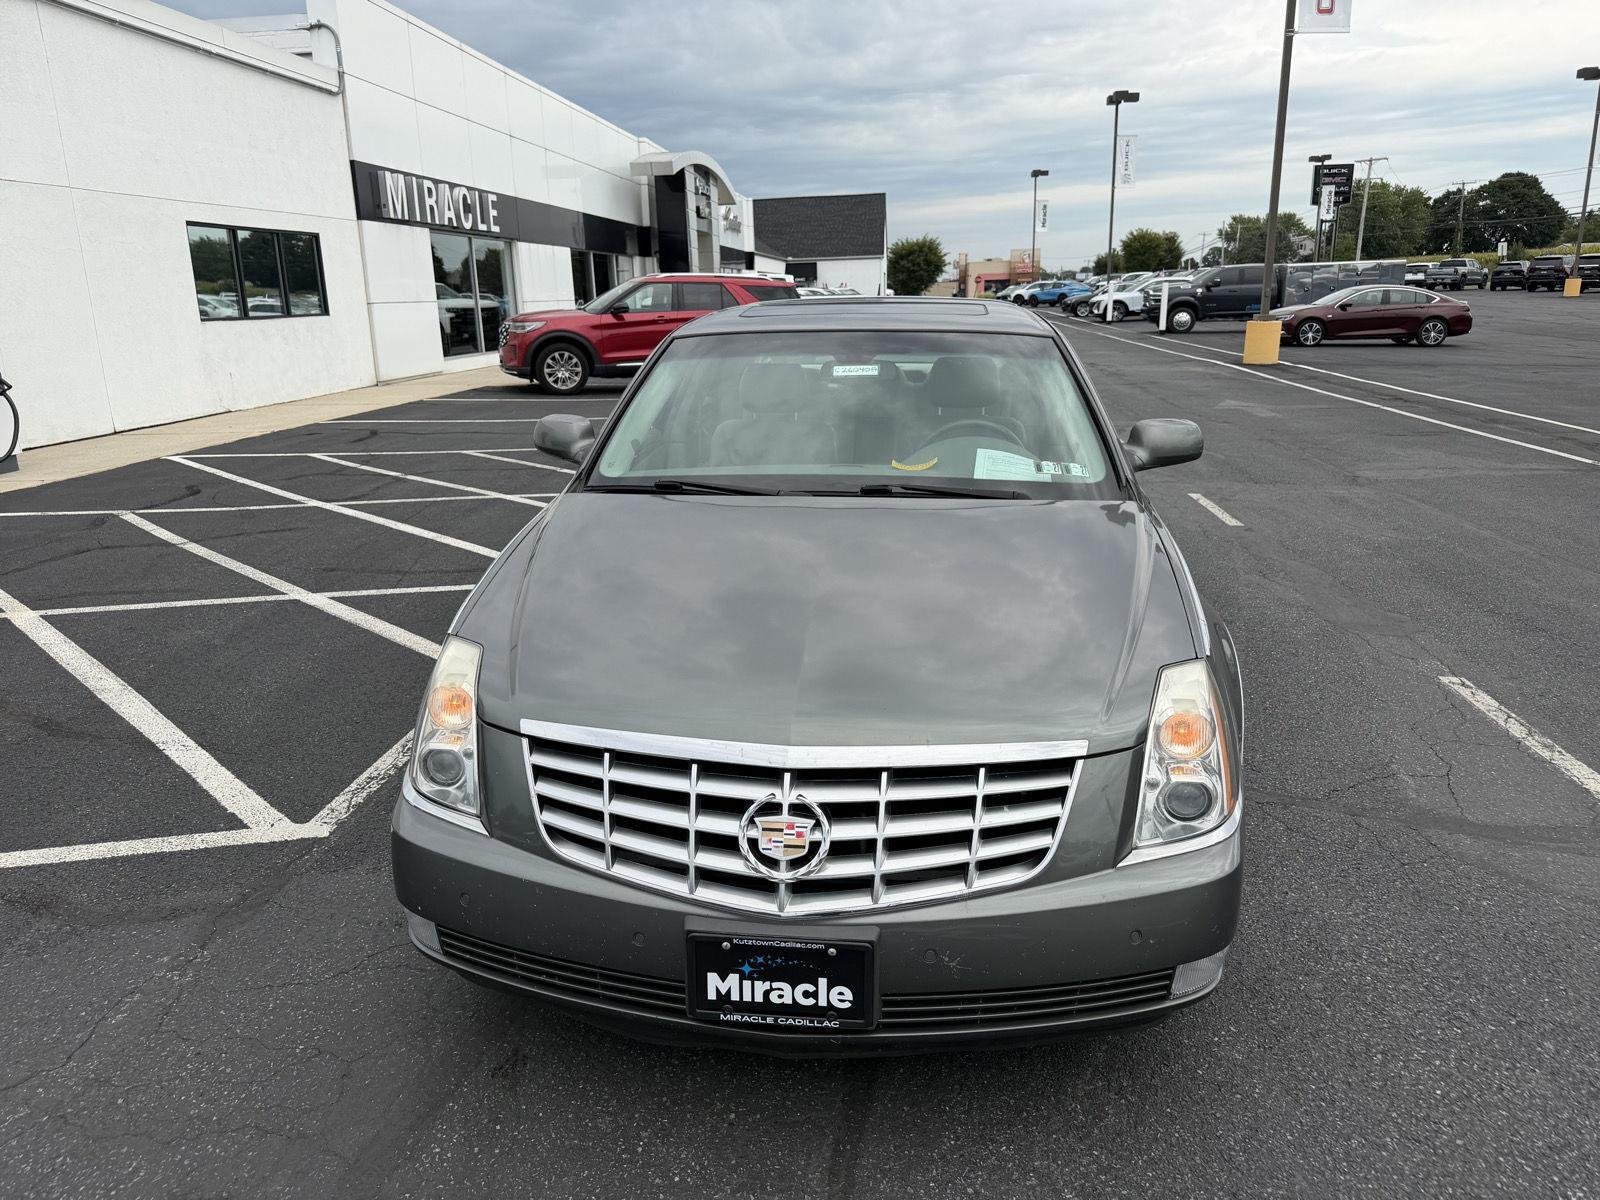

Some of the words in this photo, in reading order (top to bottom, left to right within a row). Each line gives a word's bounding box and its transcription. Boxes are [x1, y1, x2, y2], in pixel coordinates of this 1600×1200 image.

[378, 171, 500, 233] MIRACLE
[1325, 190, 1333, 215] Miracle
[732, 938, 826, 950] KutztownCadillac.com
[706, 971, 854, 1009] Miracle
[720, 1013, 775, 1024] MIRACLE
[777, 1017, 840, 1028] CADILLAC
